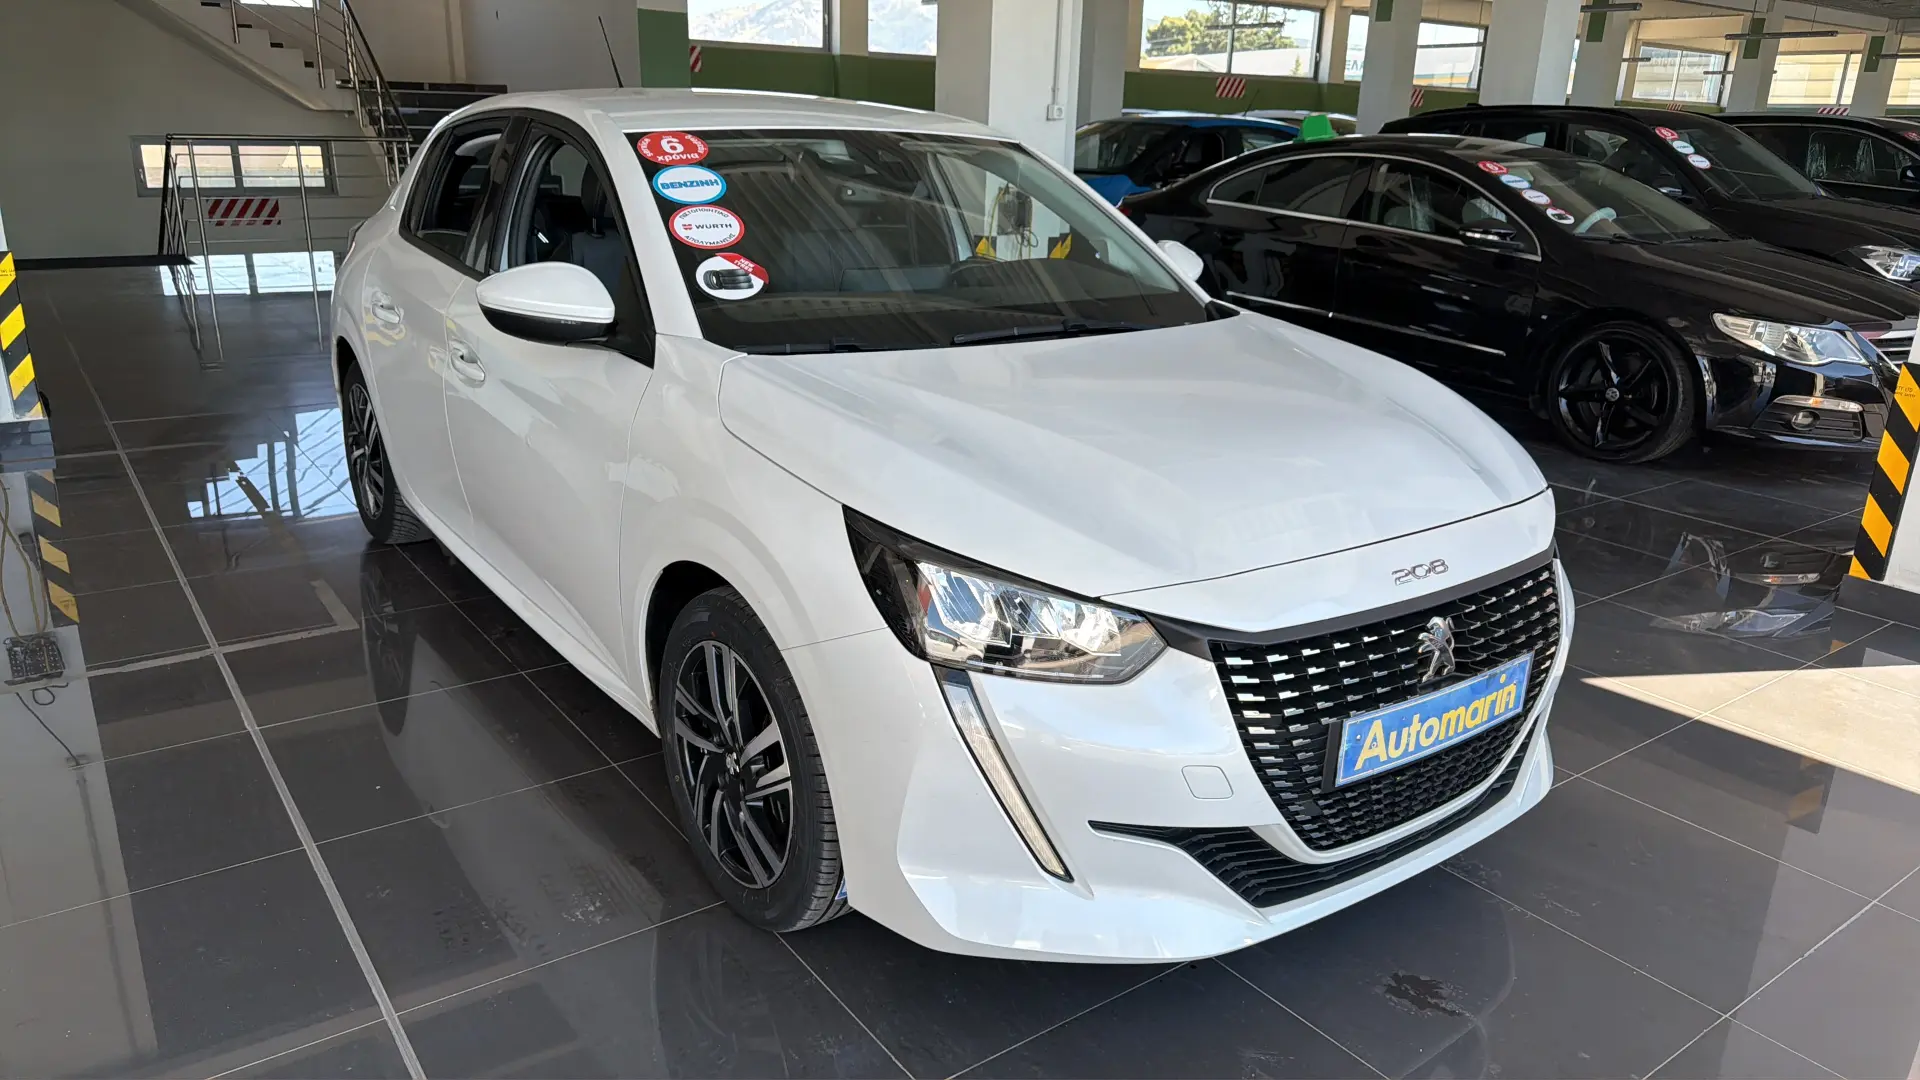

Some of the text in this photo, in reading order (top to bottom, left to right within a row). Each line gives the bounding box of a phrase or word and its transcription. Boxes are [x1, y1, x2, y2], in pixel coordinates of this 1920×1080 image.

[660, 137, 685, 154] 6
[656, 152, 700, 162] χρόνια
[739, 258, 755, 268] NEW
[1391, 558, 1449, 587] 208
[1354, 673, 1517, 771] Automarin
